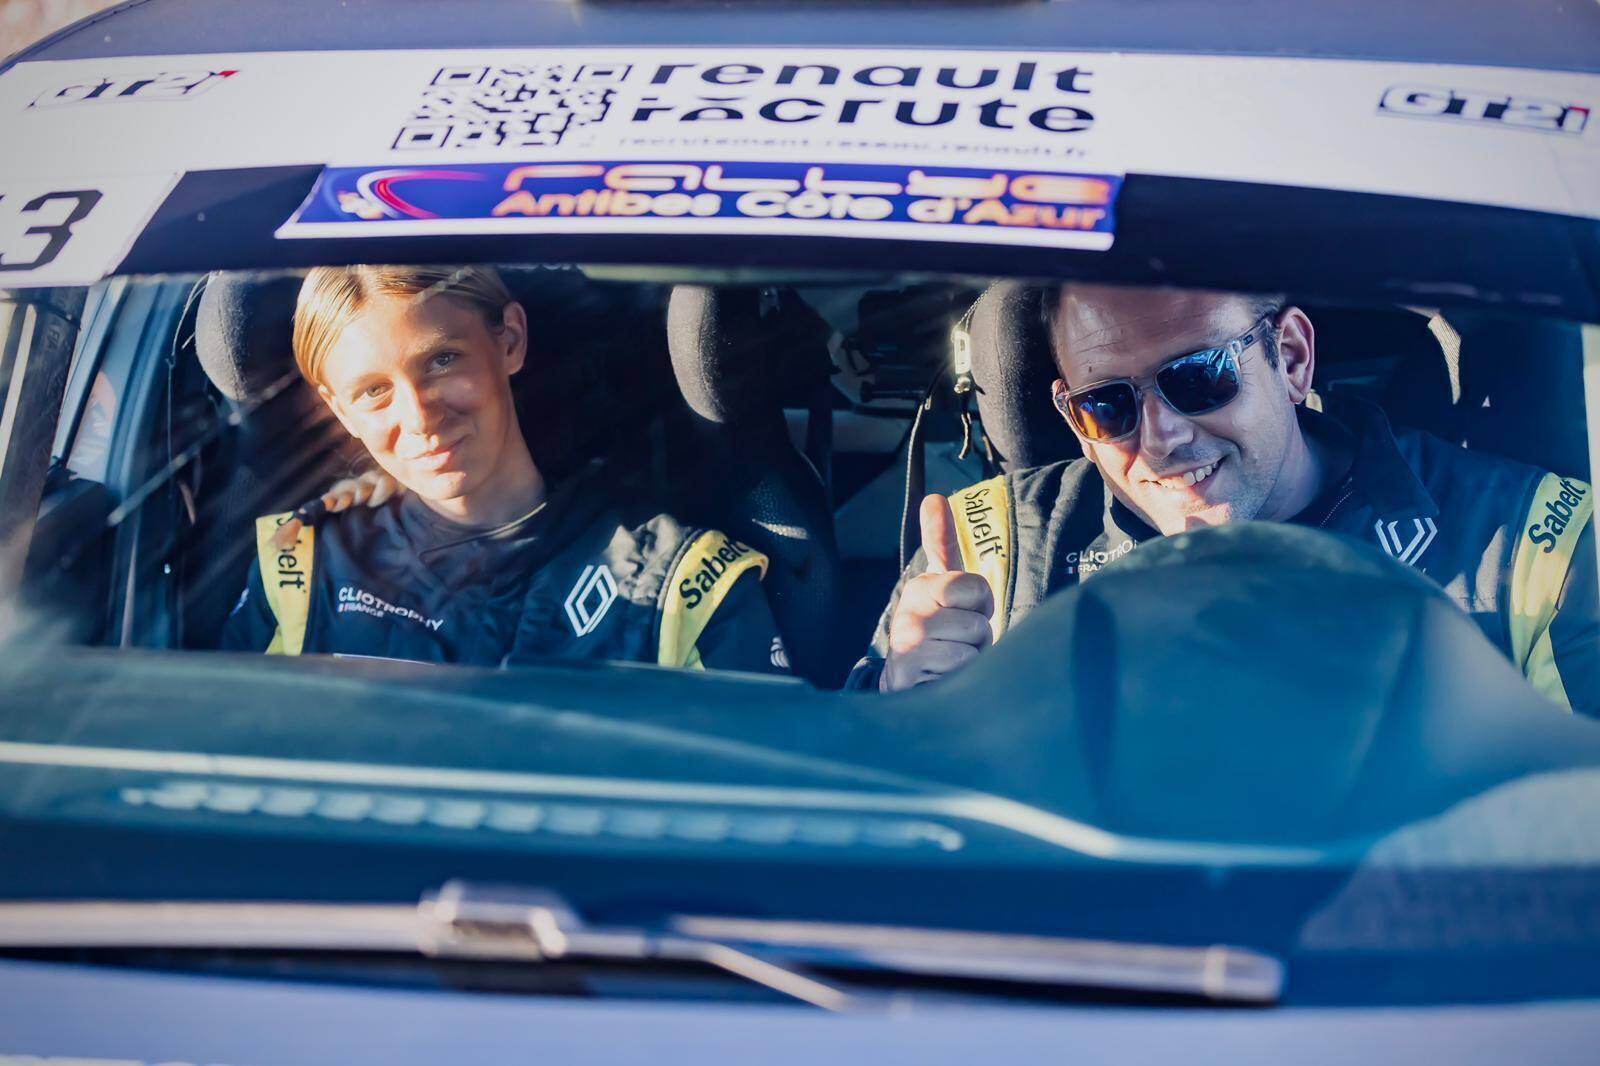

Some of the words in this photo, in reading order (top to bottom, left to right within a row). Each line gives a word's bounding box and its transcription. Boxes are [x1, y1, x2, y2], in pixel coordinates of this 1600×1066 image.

[650, 62, 1093, 93] renault
[632, 97, 1095, 132] recrute
[0, 189, 103, 271] 3
[492, 189, 725, 216] Antibes
[907, 197, 1106, 230] d'Azur
[963, 488, 1005, 562] Sabelt
[1528, 479, 1587, 554] Sabelt
[276, 511, 305, 590] Selt
[338, 586, 444, 631] CLIOTROPHY
